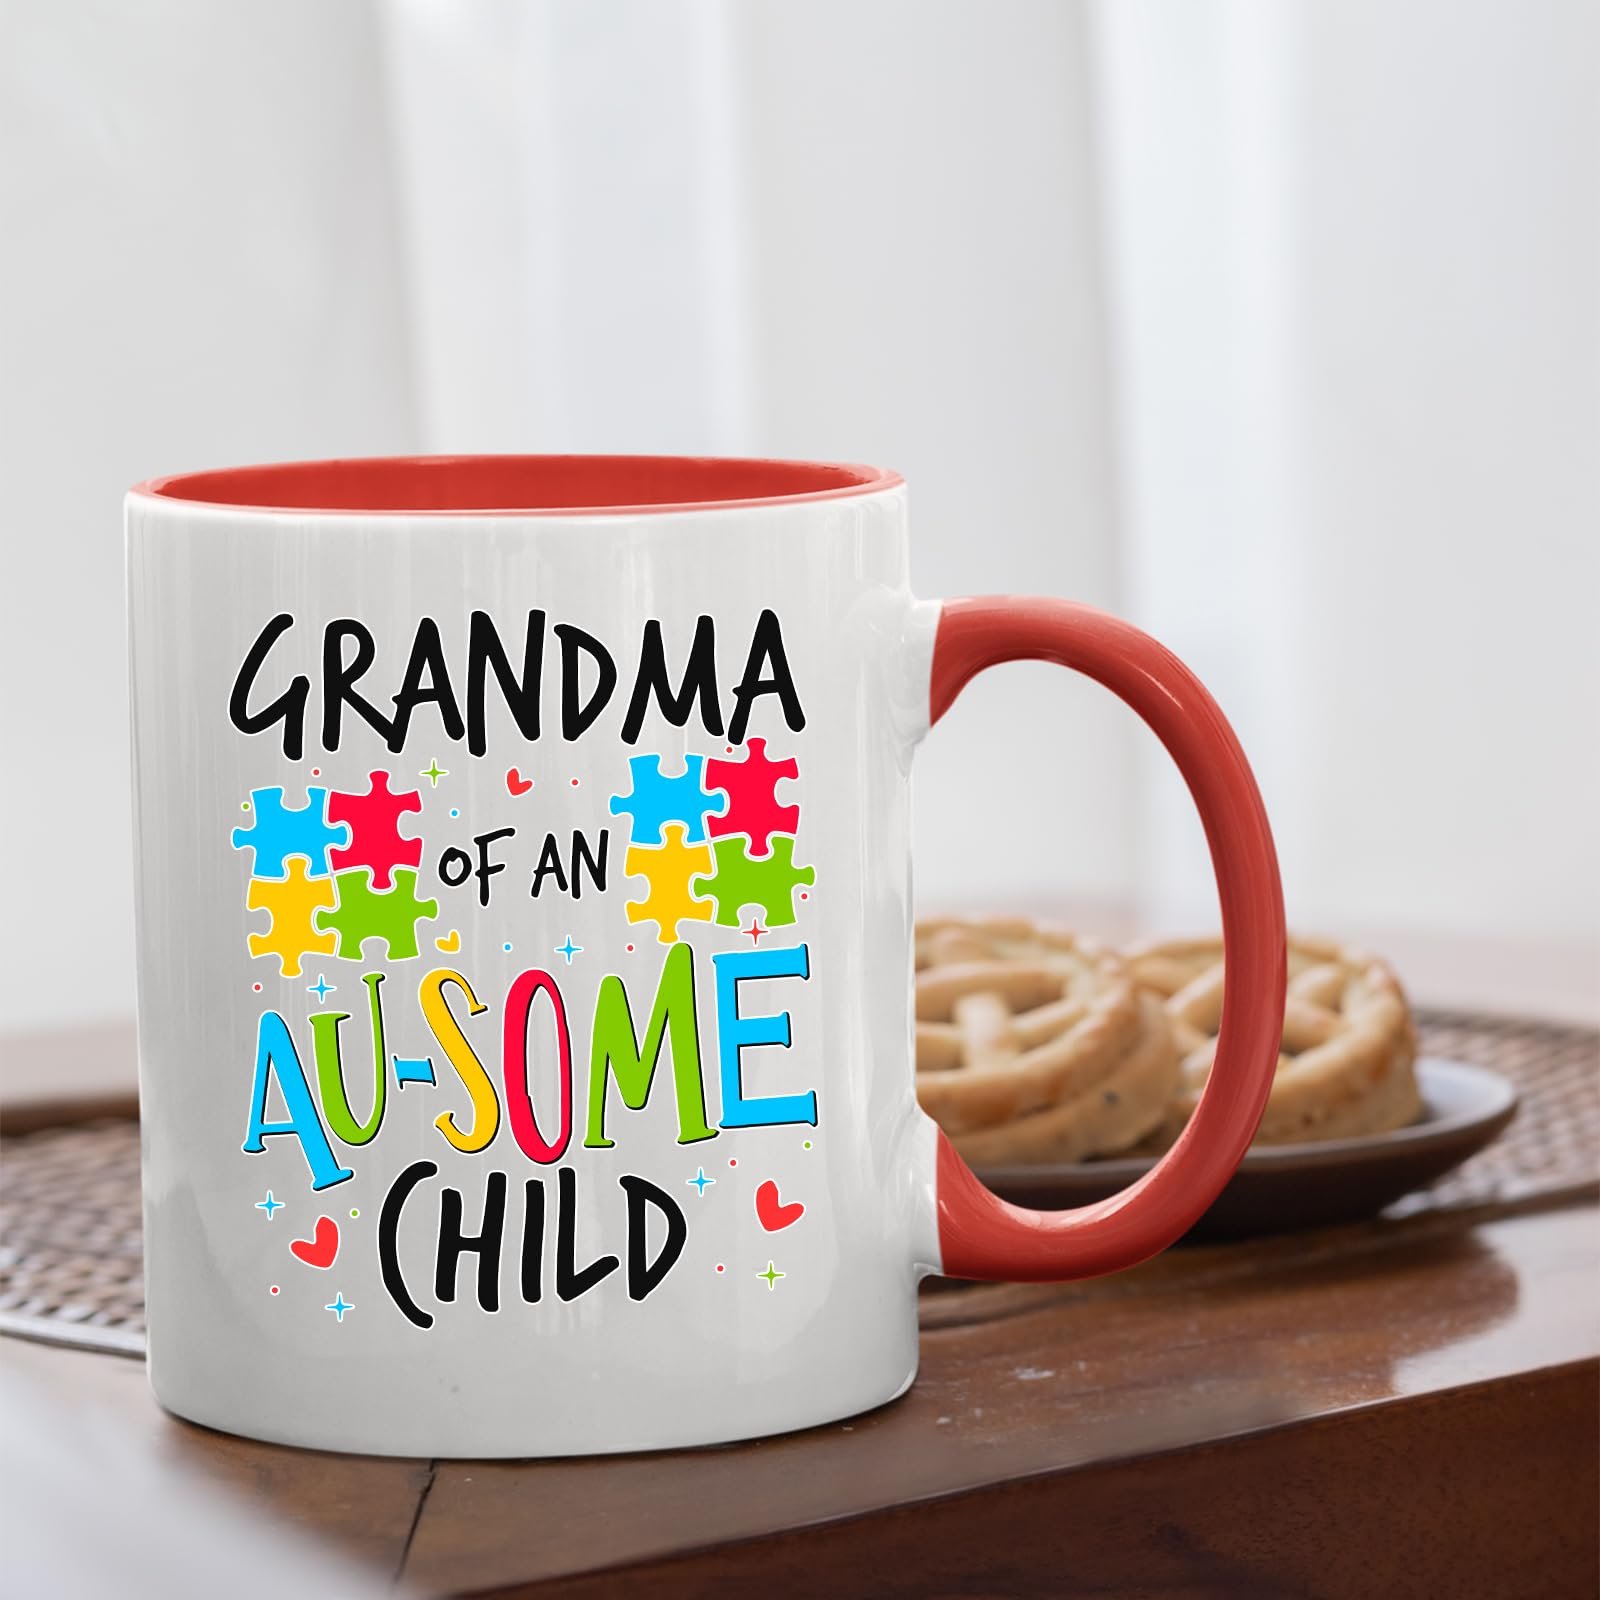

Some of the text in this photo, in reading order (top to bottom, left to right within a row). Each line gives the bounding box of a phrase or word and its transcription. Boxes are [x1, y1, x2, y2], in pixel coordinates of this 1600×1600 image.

[229, 609, 806, 761] GRANDMA
[438, 827, 609, 907] OF AN
[243, 942, 819, 1192] AU-SOME
[378, 1161, 687, 1329] CHILD
